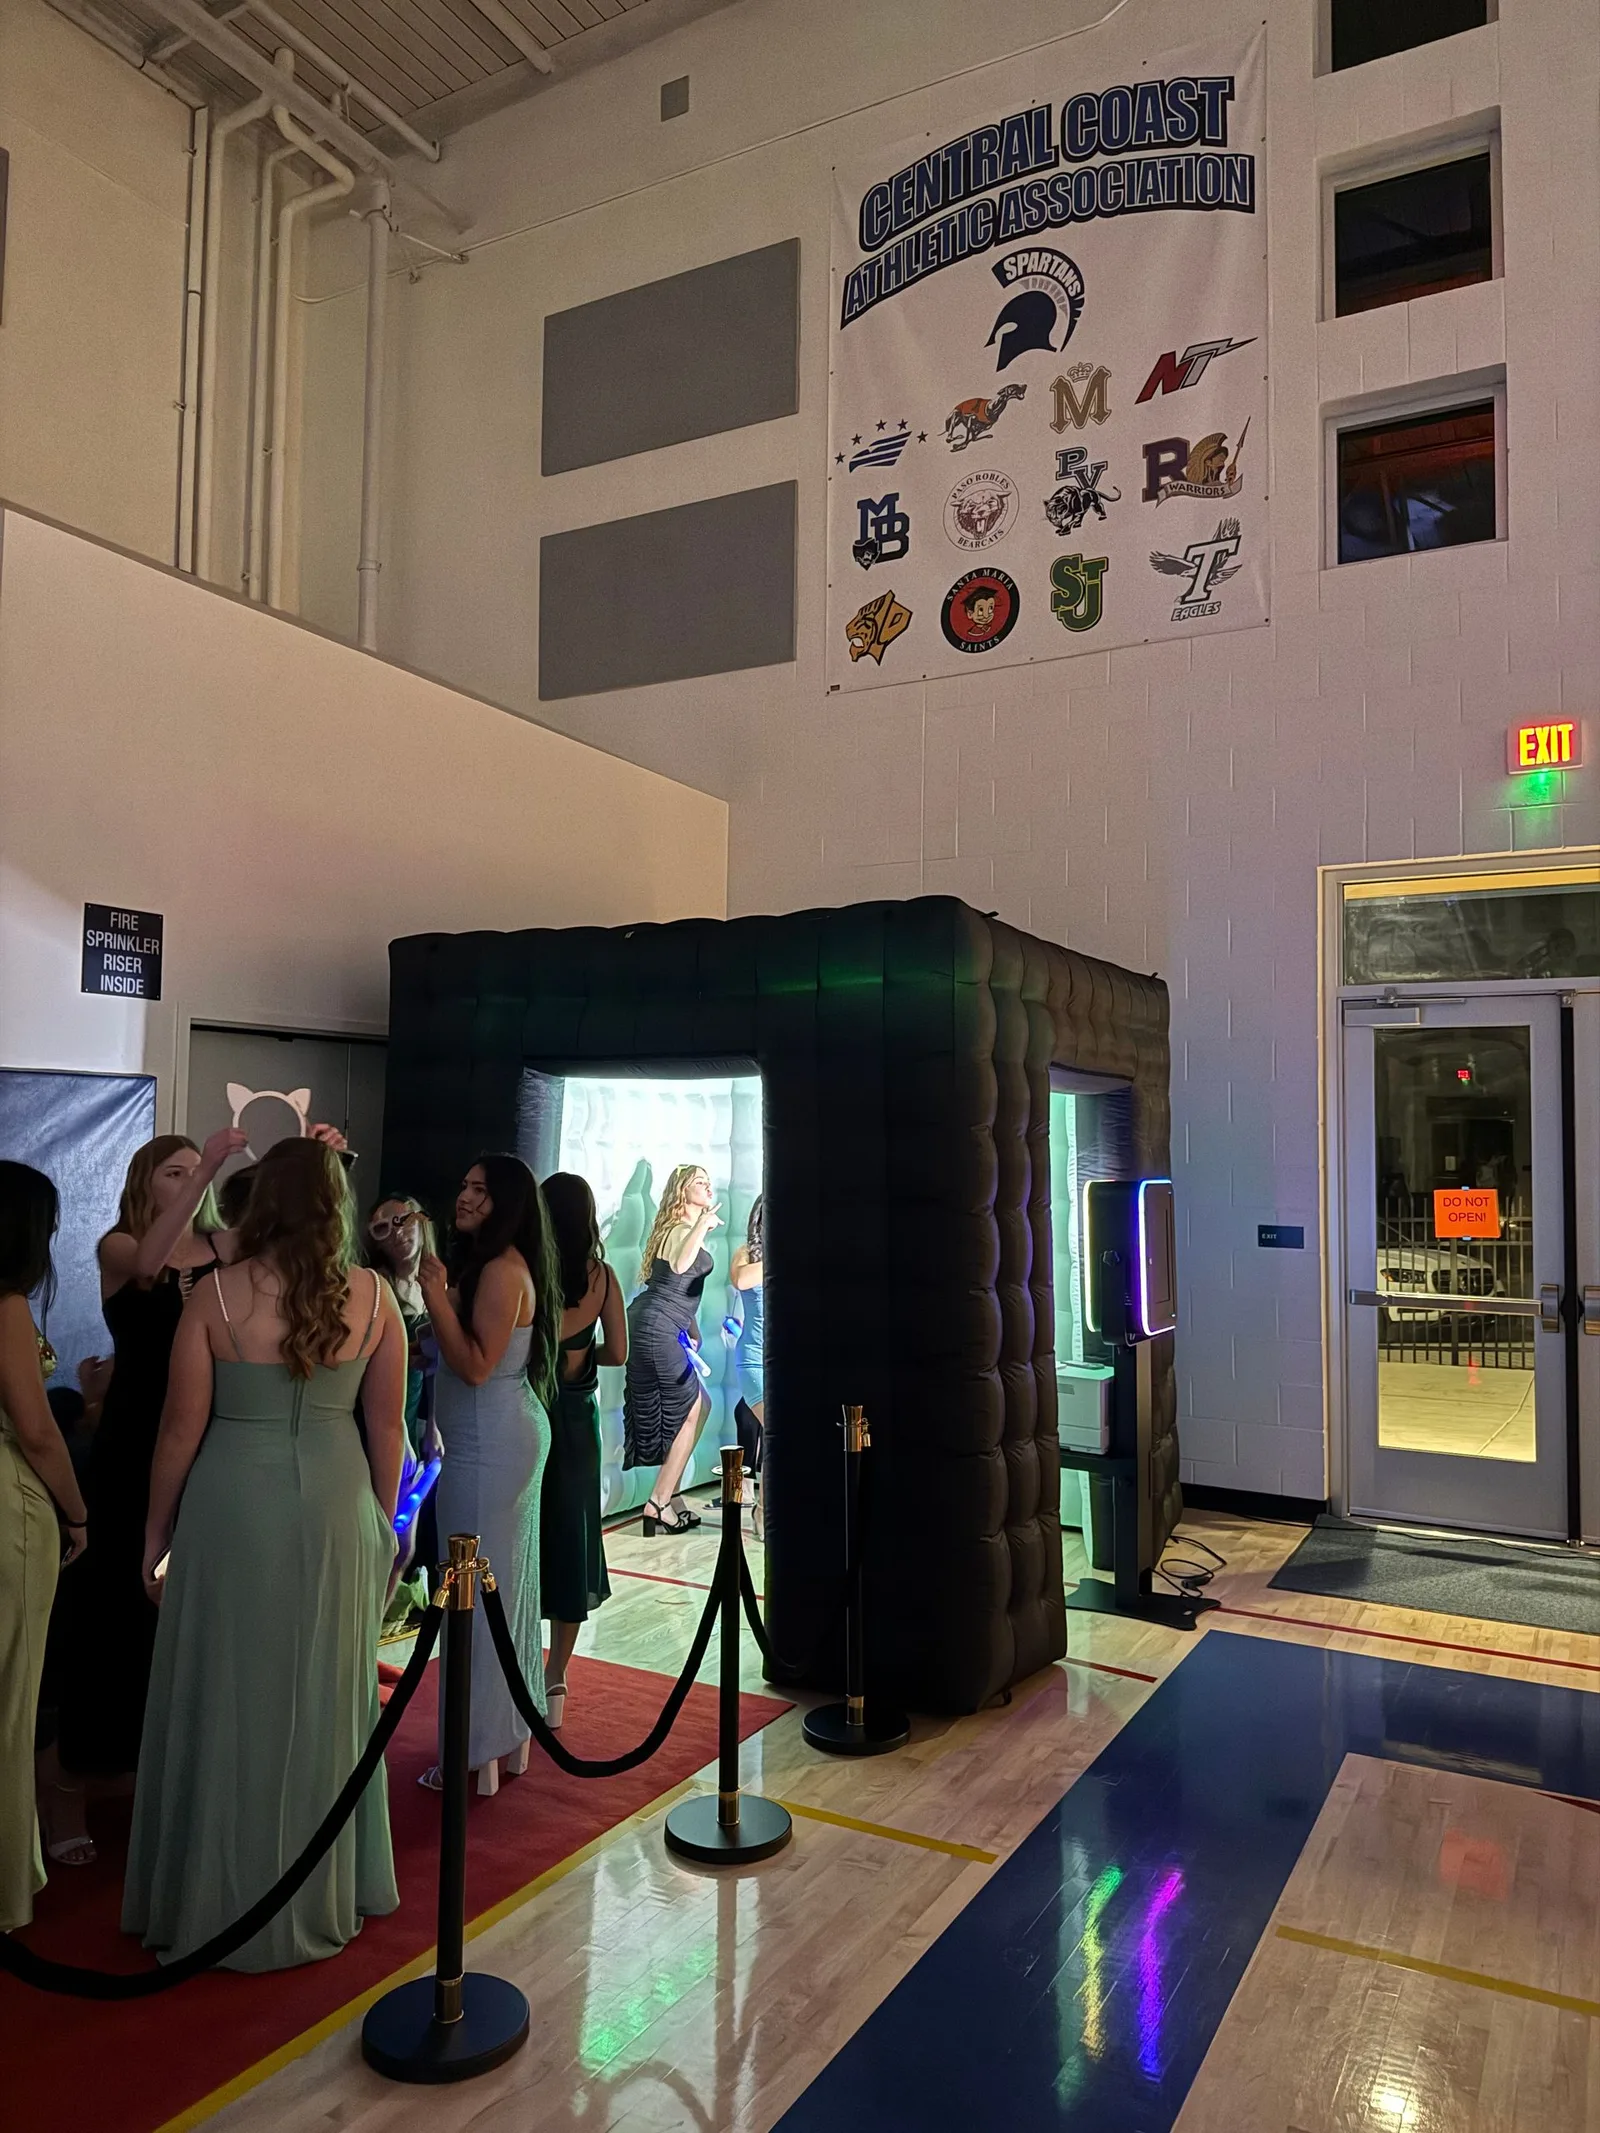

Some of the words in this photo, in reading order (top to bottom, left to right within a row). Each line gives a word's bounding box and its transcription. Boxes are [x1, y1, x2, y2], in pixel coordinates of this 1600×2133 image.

[860, 105, 1058, 251] CENTRAL
[1061, 76, 1234, 162] COAST
[841, 198, 997, 329] ATHLETIC
[995, 153, 1255, 246] ASSOCIATION
[1003, 251, 1081, 297] SPARTANS
[1049, 365, 1112, 435] M
[1142, 437, 1190, 503] R
[951, 477, 974, 499] PASO
[974, 472, 1010, 490] ROBLES
[1169, 482, 1225, 496] WARRIORS
[957, 528, 1005, 549] BEARCATS
[947, 571, 978, 602] SANTA
[982, 568, 1014, 591] MARIA
[1171, 601, 1221, 621] EAGLES
[959, 635, 1000, 652] SAINTS
[1519, 723, 1574, 766] EXIT
[110, 911, 139, 931] FIRE
[86, 929, 160, 955] SPRINKLER
[103, 953, 142, 974] RISER
[100, 974, 144, 995] INSIDE
[1443, 1197, 1461, 1207] DO
[1465, 1197, 1489, 1207] NOT
[1448, 1212, 1486, 1222] OPEN!
